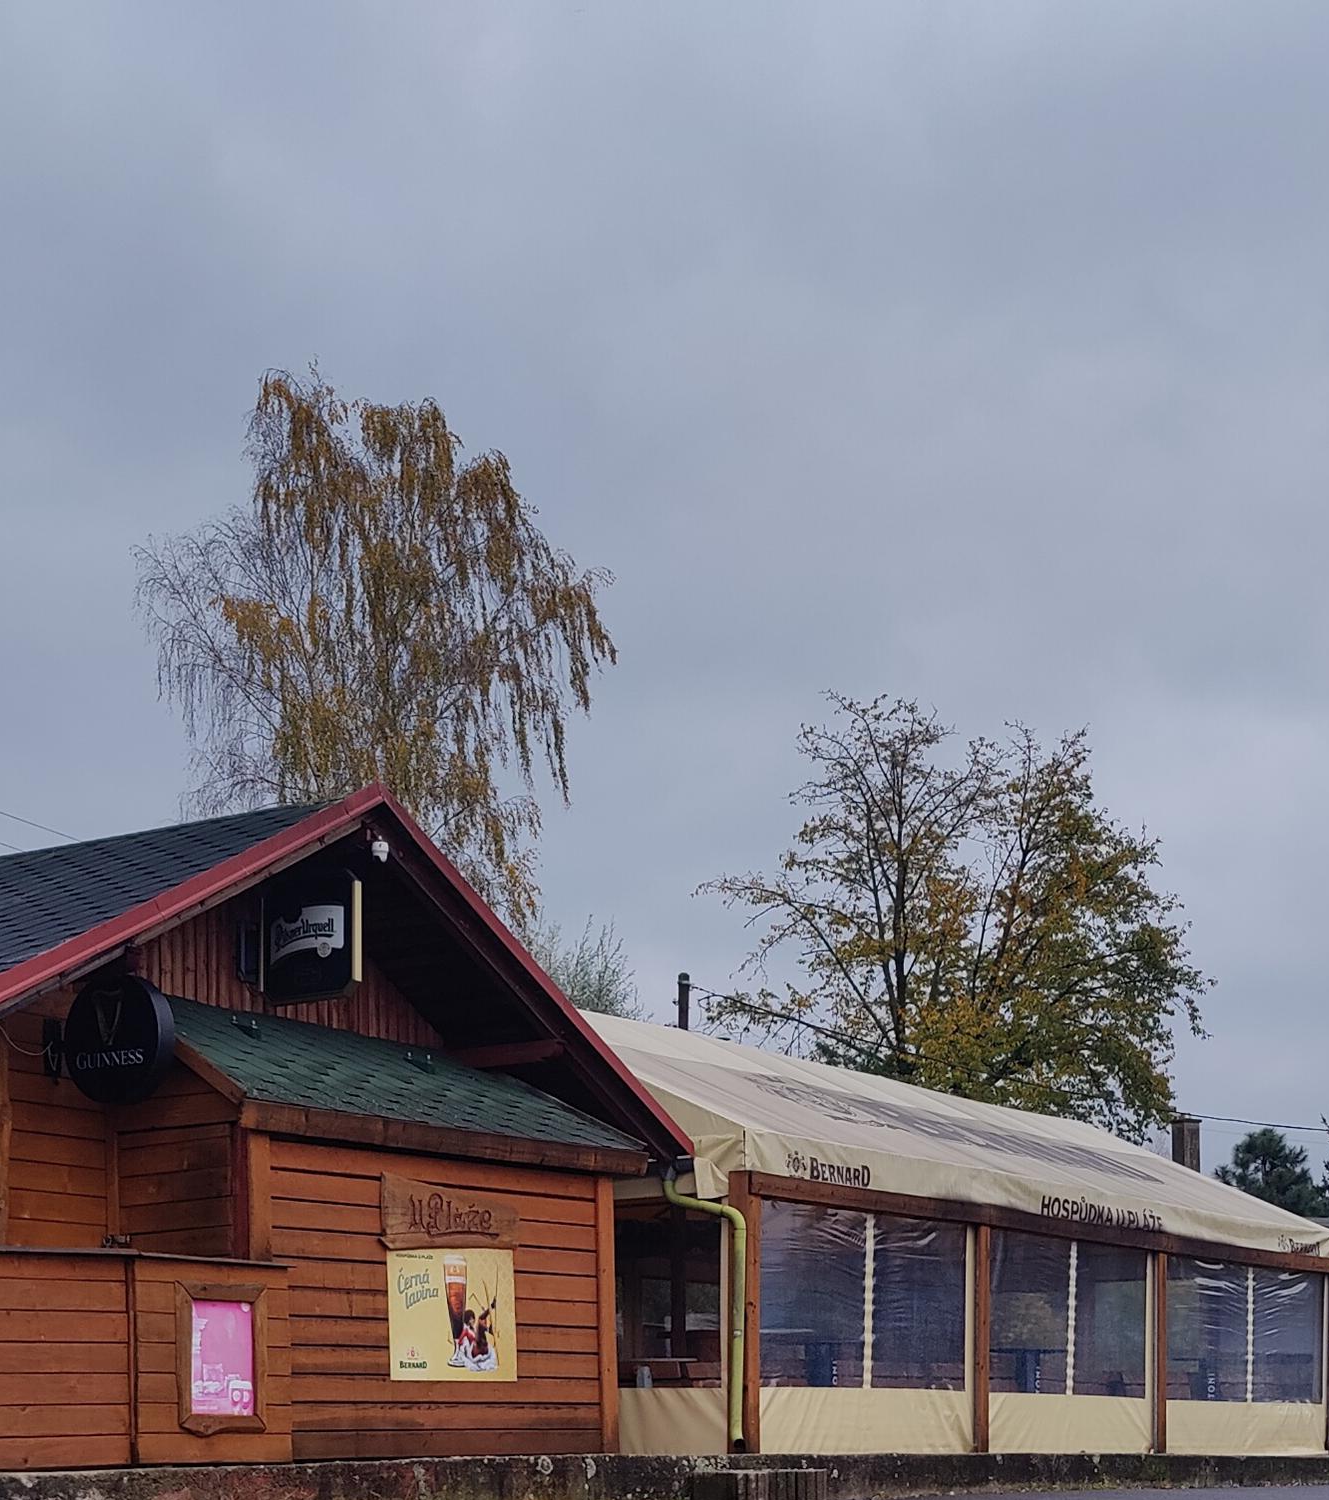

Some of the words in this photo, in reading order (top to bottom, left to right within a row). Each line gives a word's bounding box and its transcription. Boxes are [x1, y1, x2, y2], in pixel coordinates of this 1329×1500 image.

[301, 918, 335, 940] Urquell
[76, 1048, 145, 1070] GUINNESS
[809, 1156, 871, 1188] BERNARD
[1041, 1194, 1113, 1227] HOSPŮDKA
